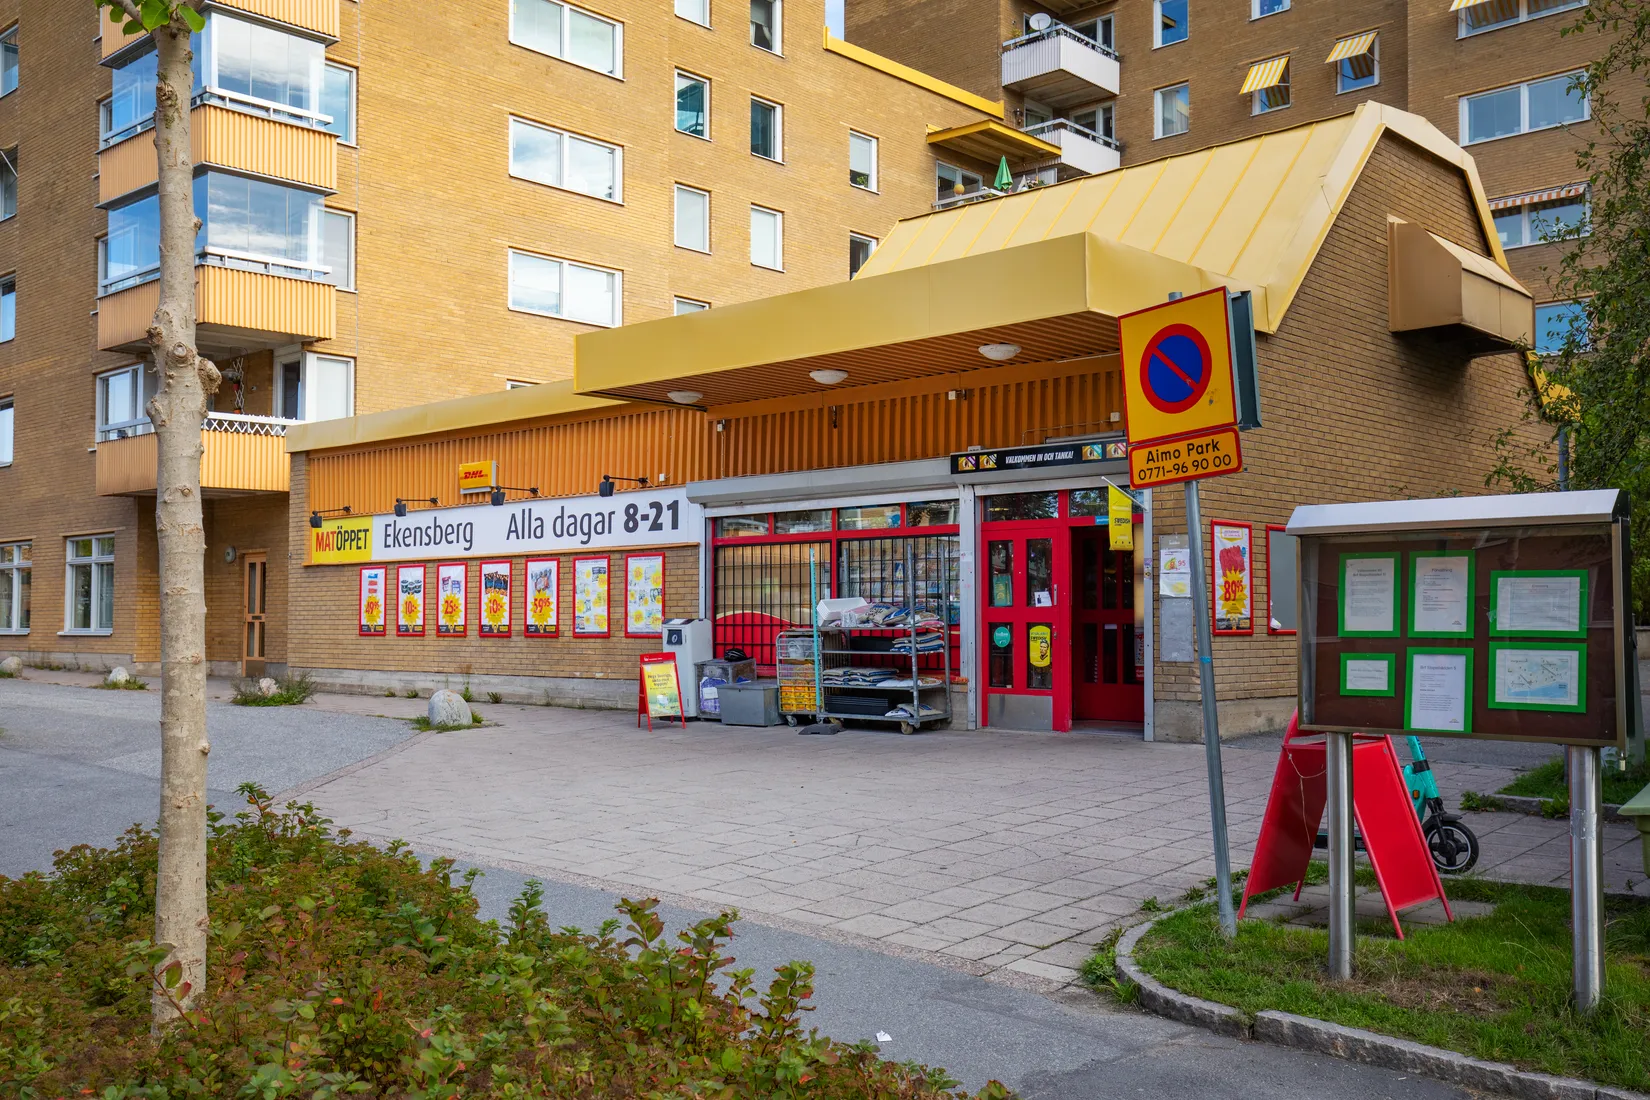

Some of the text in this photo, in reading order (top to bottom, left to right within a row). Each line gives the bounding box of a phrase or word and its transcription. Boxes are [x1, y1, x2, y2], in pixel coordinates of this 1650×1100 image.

[1044, 452, 1054, 461] OCH
[1146, 439, 1220, 464] Aimo Park
[463, 470, 484, 479] DHL
[1138, 454, 1232, 480] 0771-96 90 00
[384, 500, 679, 551] Ekensberg Alla dagar 8-21
[316, 526, 370, 552] MATÖPPET
